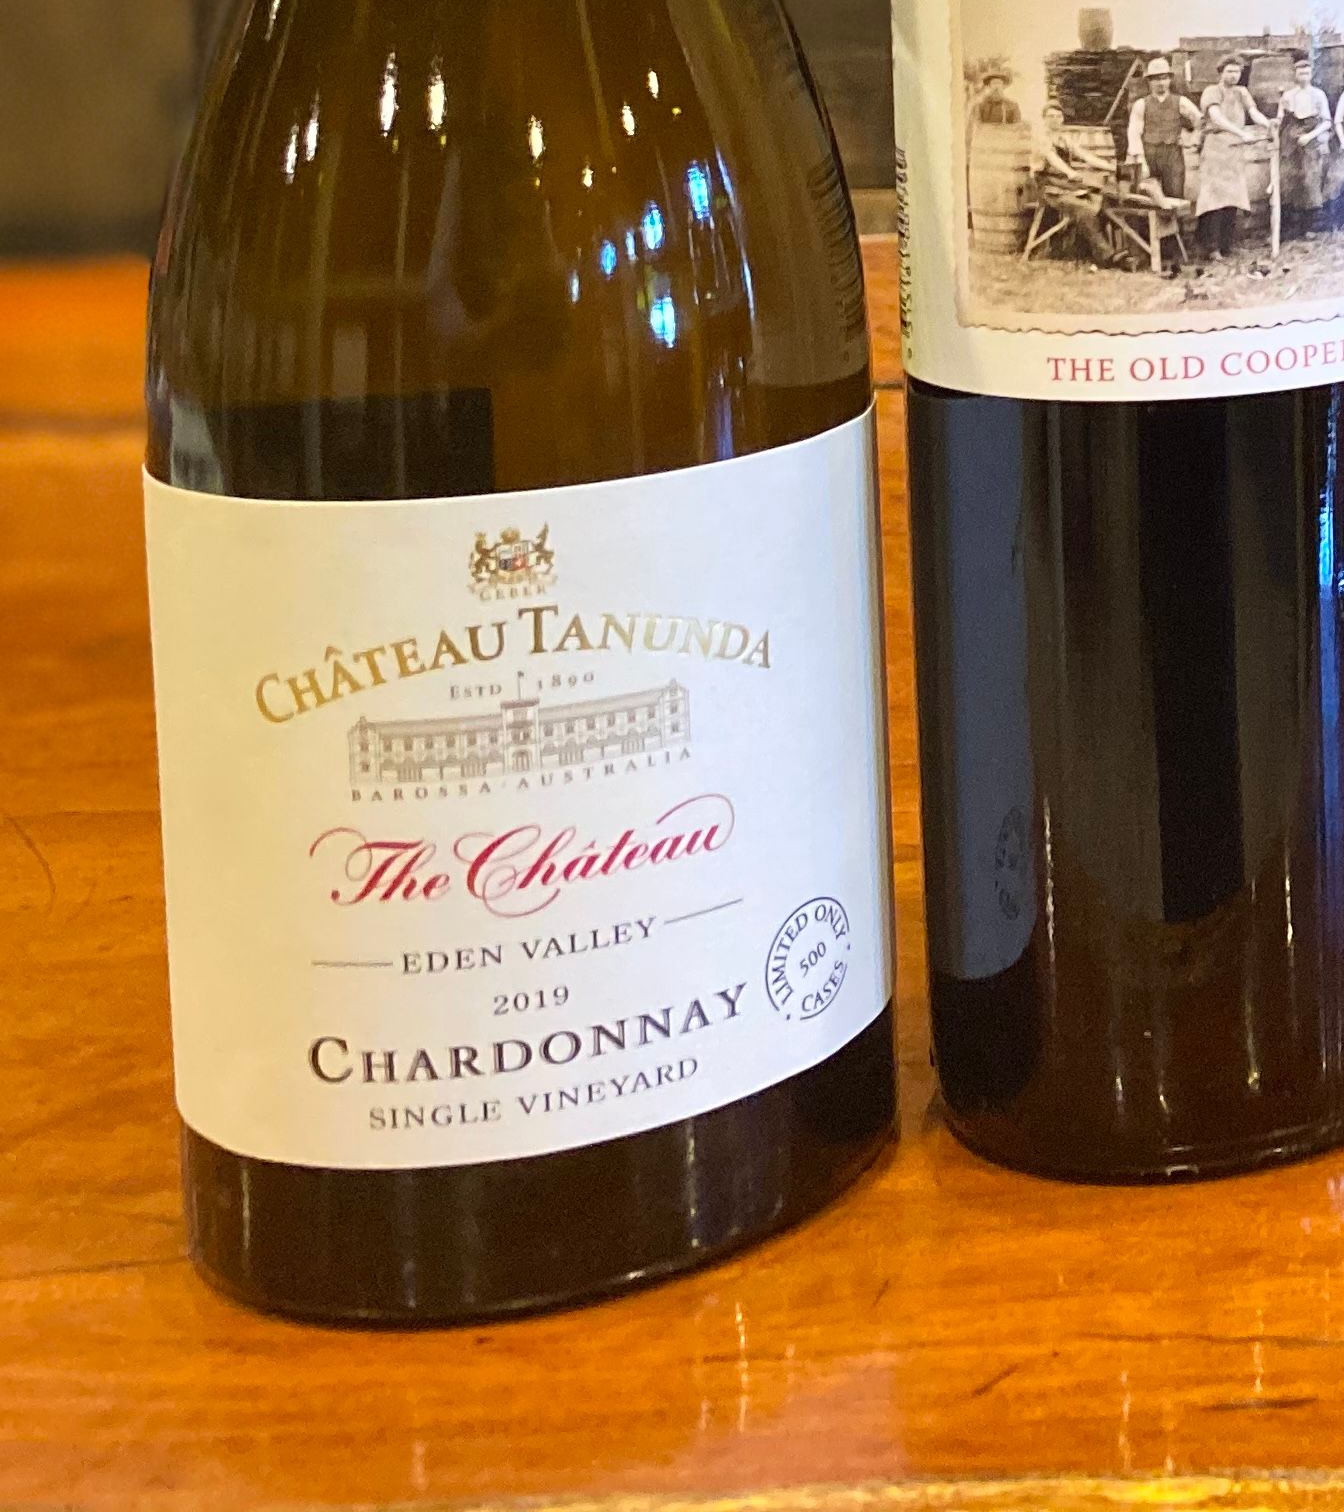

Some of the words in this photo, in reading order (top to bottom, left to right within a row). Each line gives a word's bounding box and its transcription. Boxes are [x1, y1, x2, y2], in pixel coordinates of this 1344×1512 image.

[1046, 354, 1116, 384] THE
[1127, 355, 1205, 384] OLD
[255, 620, 508, 726] CHÂTEAU
[516, 604, 773, 670] TANUNDA
[536, 670, 596, 691] 1890
[350, 778, 495, 803] BAROSSA
[517, 746, 693, 791] AUSTRALIA
[308, 825, 452, 908] The
[452, 793, 737, 919] Château
[401, 943, 504, 976] EDEN
[520, 915, 659, 961] VALLEY
[770, 911, 811, 1010] LIMITED
[813, 902, 850, 943] ONLY
[797, 939, 829, 979] 500
[491, 985, 572, 1016] 2019
[799, 958, 850, 1016] CASES
[307, 981, 750, 1086] CHARDONNAY
[368, 1100, 503, 1131] SINGLE
[517, 1055, 701, 1118] VINEYARD
